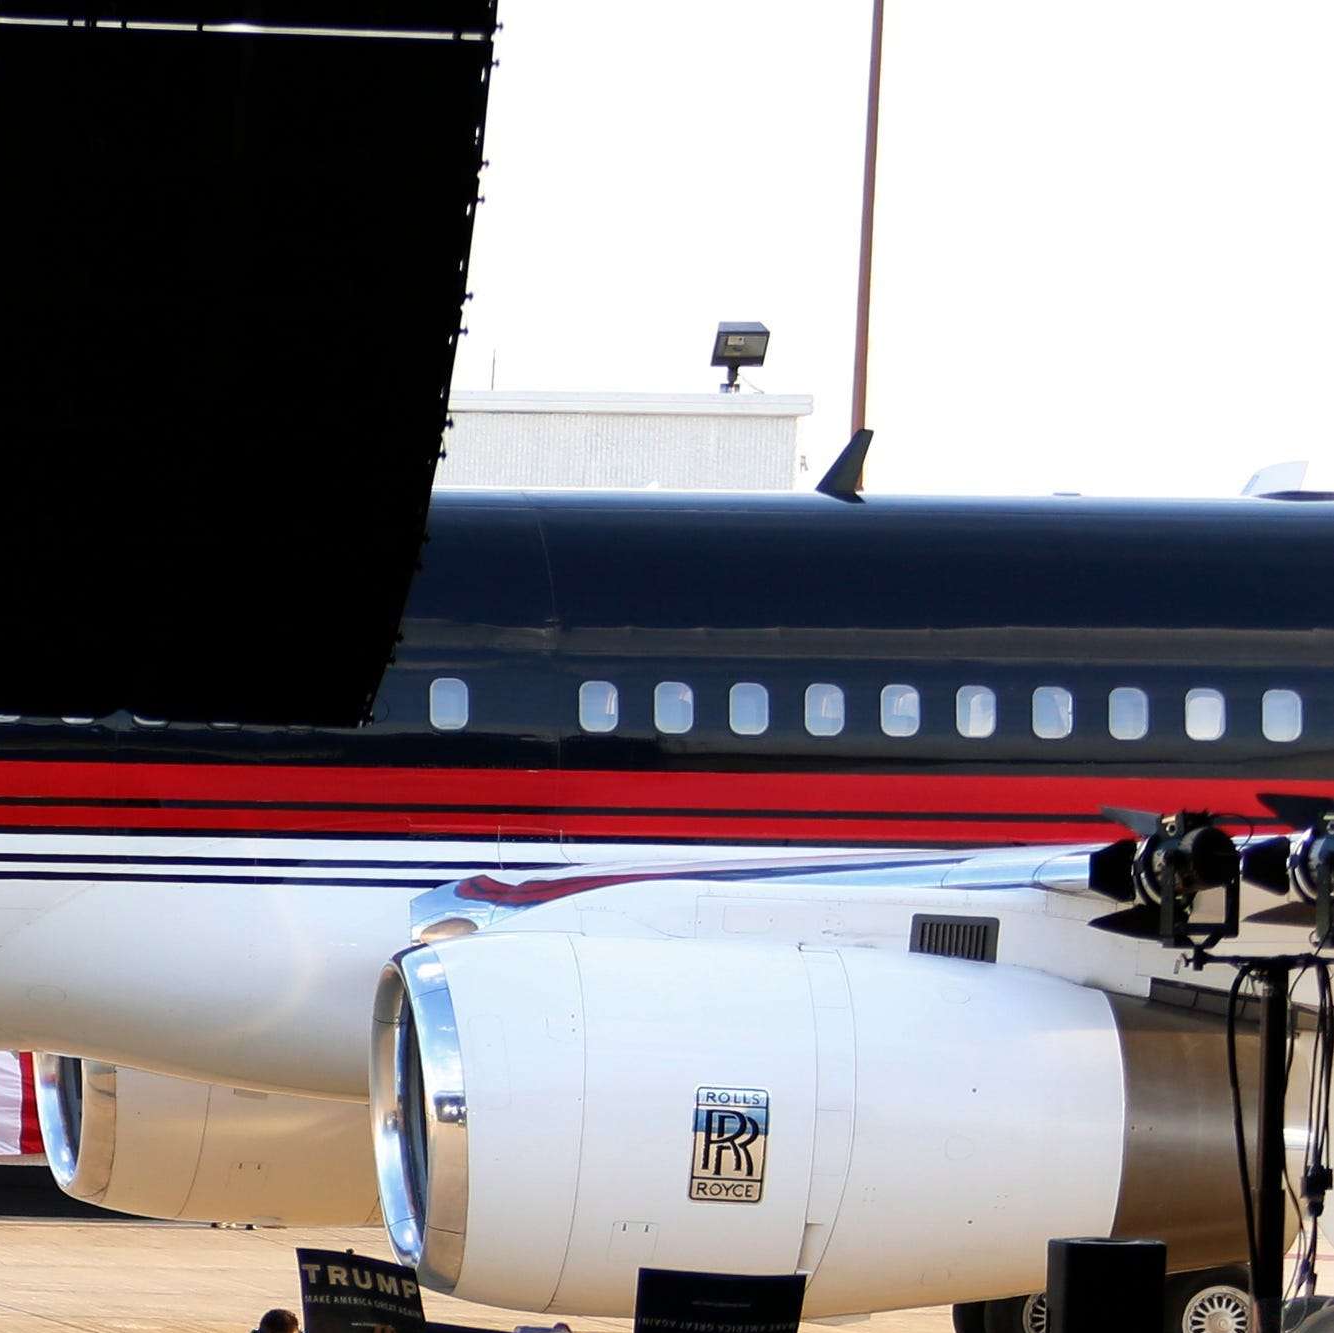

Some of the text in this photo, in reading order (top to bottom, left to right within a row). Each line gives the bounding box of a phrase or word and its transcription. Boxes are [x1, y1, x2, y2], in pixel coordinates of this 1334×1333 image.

[706, 1091, 761, 1105] ROLLS
[696, 1182, 755, 1198] ROYCE
[301, 1263, 418, 1298] TRUMP
